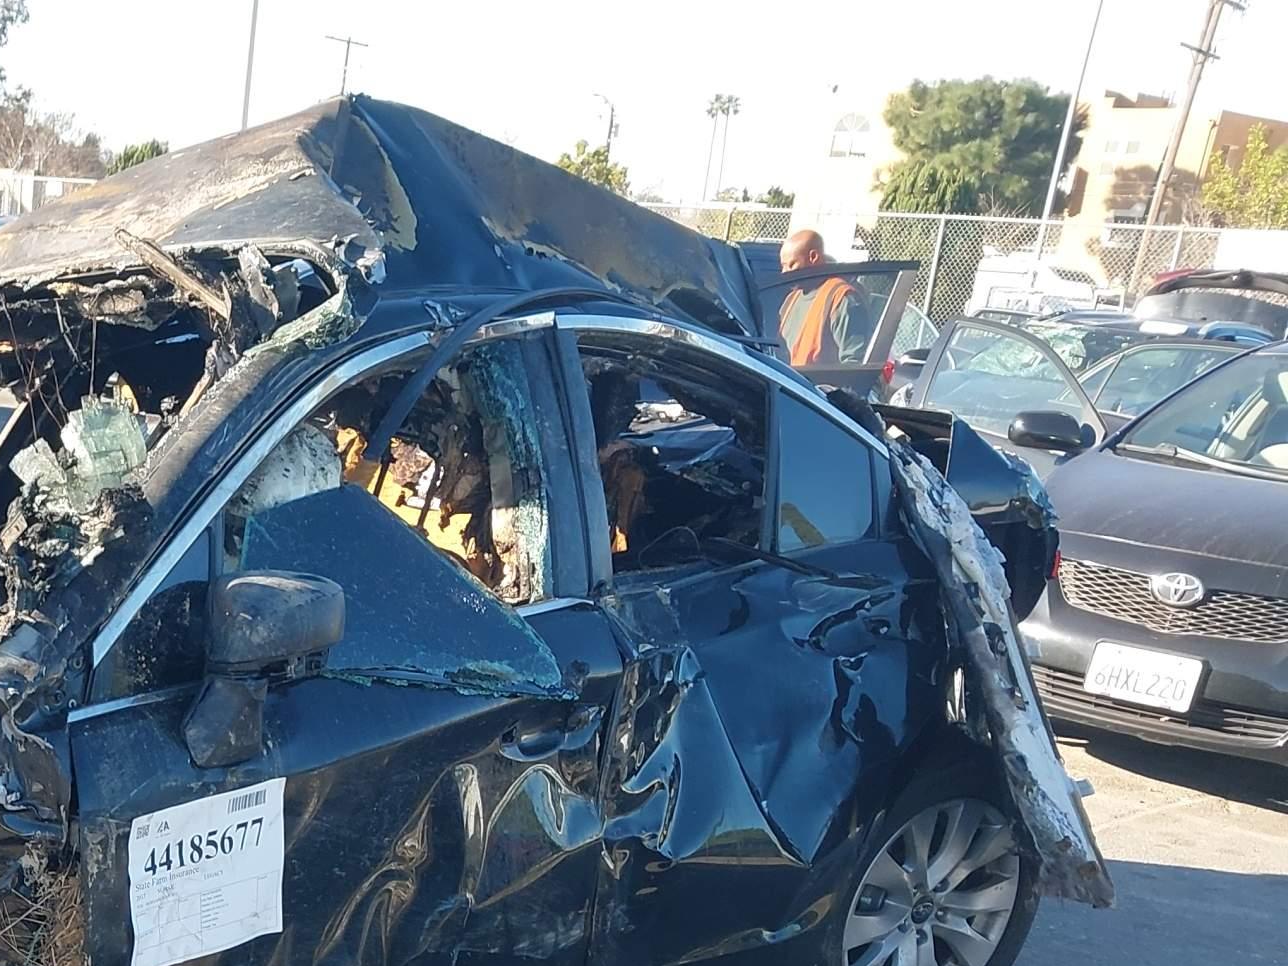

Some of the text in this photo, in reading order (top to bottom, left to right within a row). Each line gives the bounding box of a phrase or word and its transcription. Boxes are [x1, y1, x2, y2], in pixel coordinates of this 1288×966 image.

[1094, 664, 1187, 701] 6HXL220
[144, 816, 264, 876] 44185677
[135, 882, 150, 892] State
[152, 875, 168, 887] Farm
[169, 866, 200, 881] Insurance
